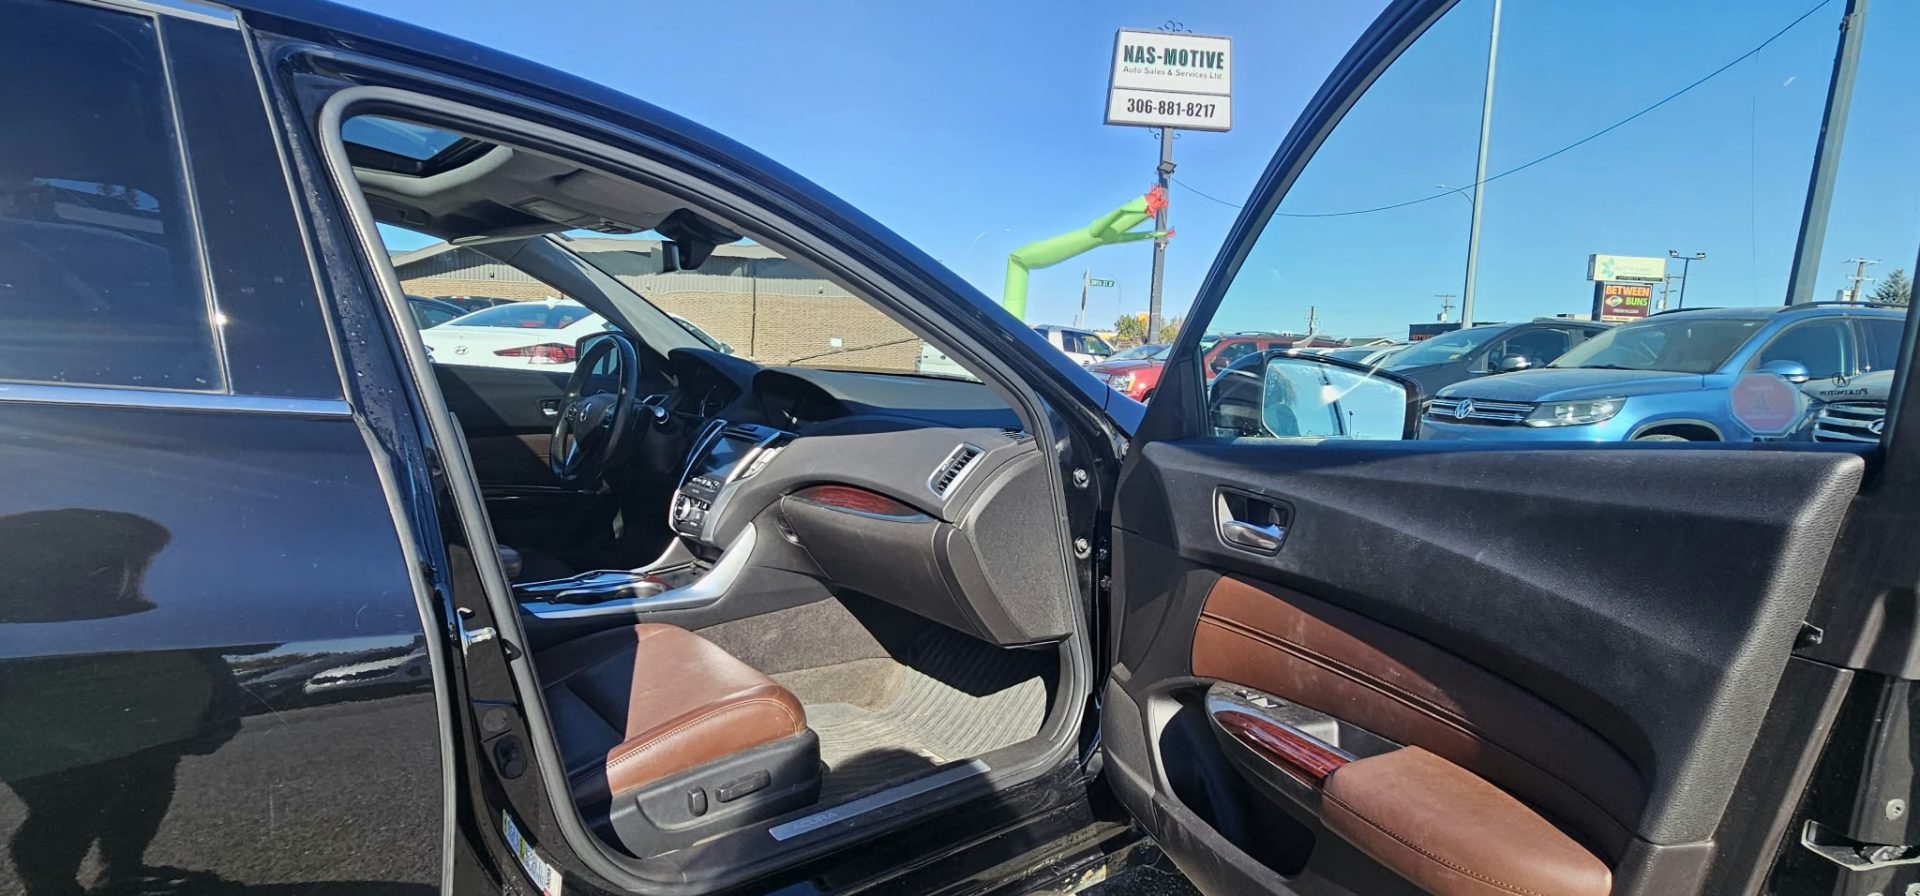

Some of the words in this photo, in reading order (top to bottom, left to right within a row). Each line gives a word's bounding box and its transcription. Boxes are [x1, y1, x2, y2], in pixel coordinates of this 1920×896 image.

[1123, 45, 1224, 69] NAS-MOTIVE
[1144, 67, 1165, 76] Sales
[1175, 69, 1208, 79] Services
[1127, 98, 1216, 118] 306-881-8217
[1605, 285, 1651, 297] BETWEEN
[1626, 297, 1648, 306] BUNS
